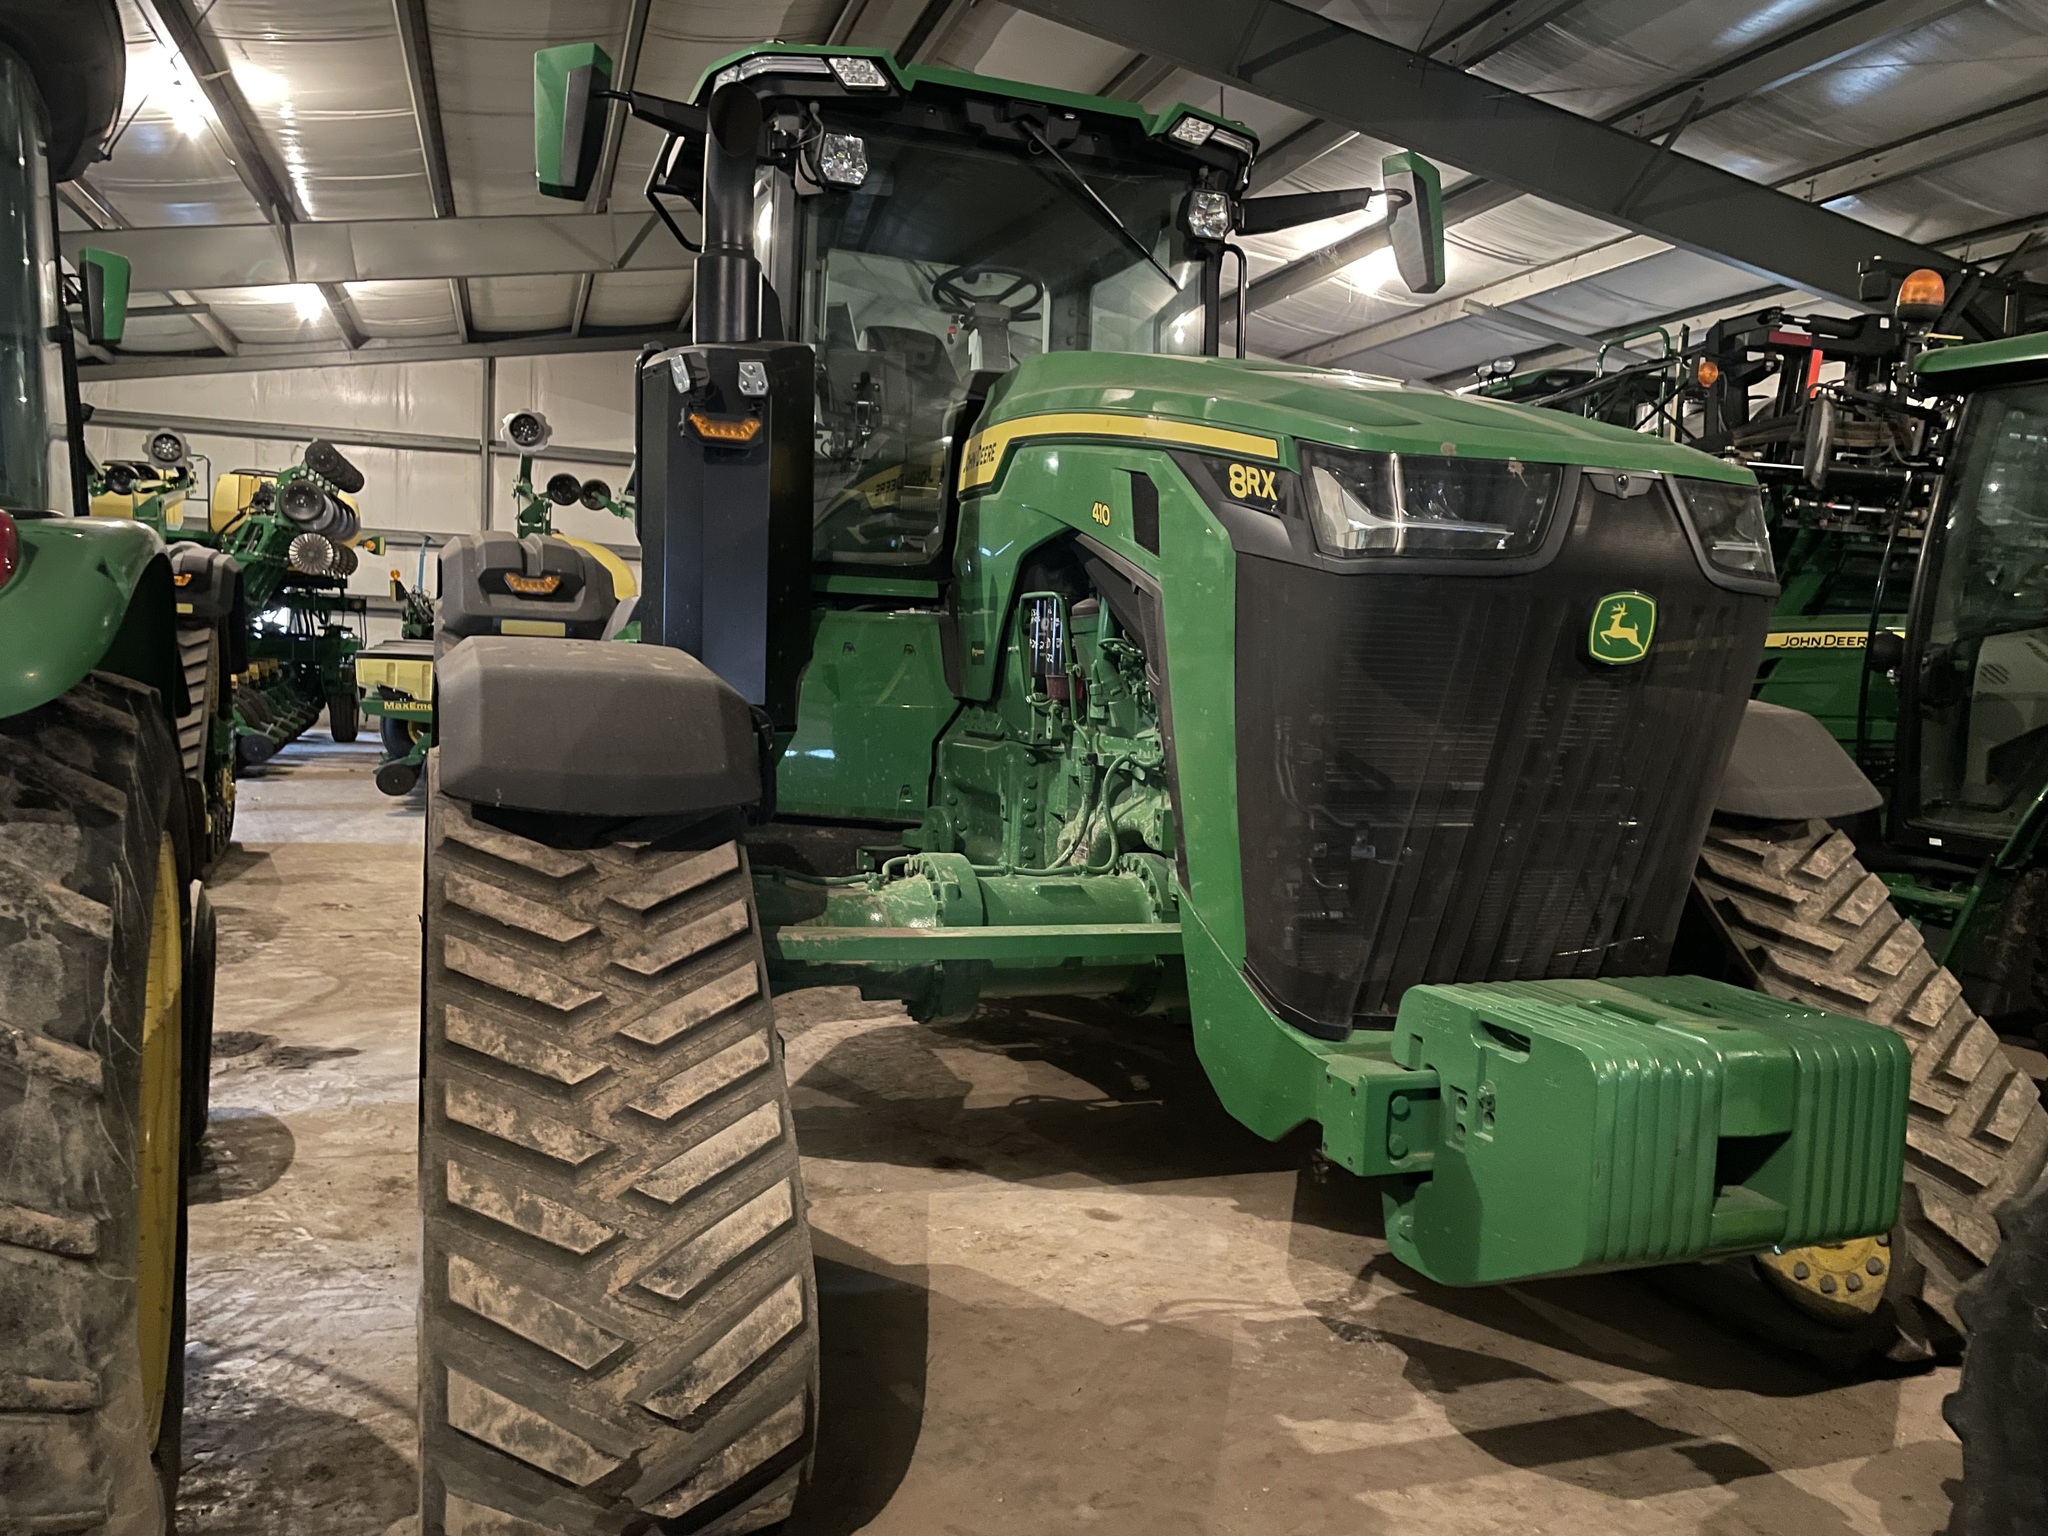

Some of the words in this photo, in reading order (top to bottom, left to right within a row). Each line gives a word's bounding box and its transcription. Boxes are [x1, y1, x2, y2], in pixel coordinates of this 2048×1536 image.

[976, 442, 997, 467] DEERE
[1229, 463, 1278, 501] 8RX
[1092, 501, 1111, 527] 410
[1780, 635, 1821, 647] JOHN
[1824, 634, 1868, 647] DEER
[384, 701, 432, 711] MaxEme
